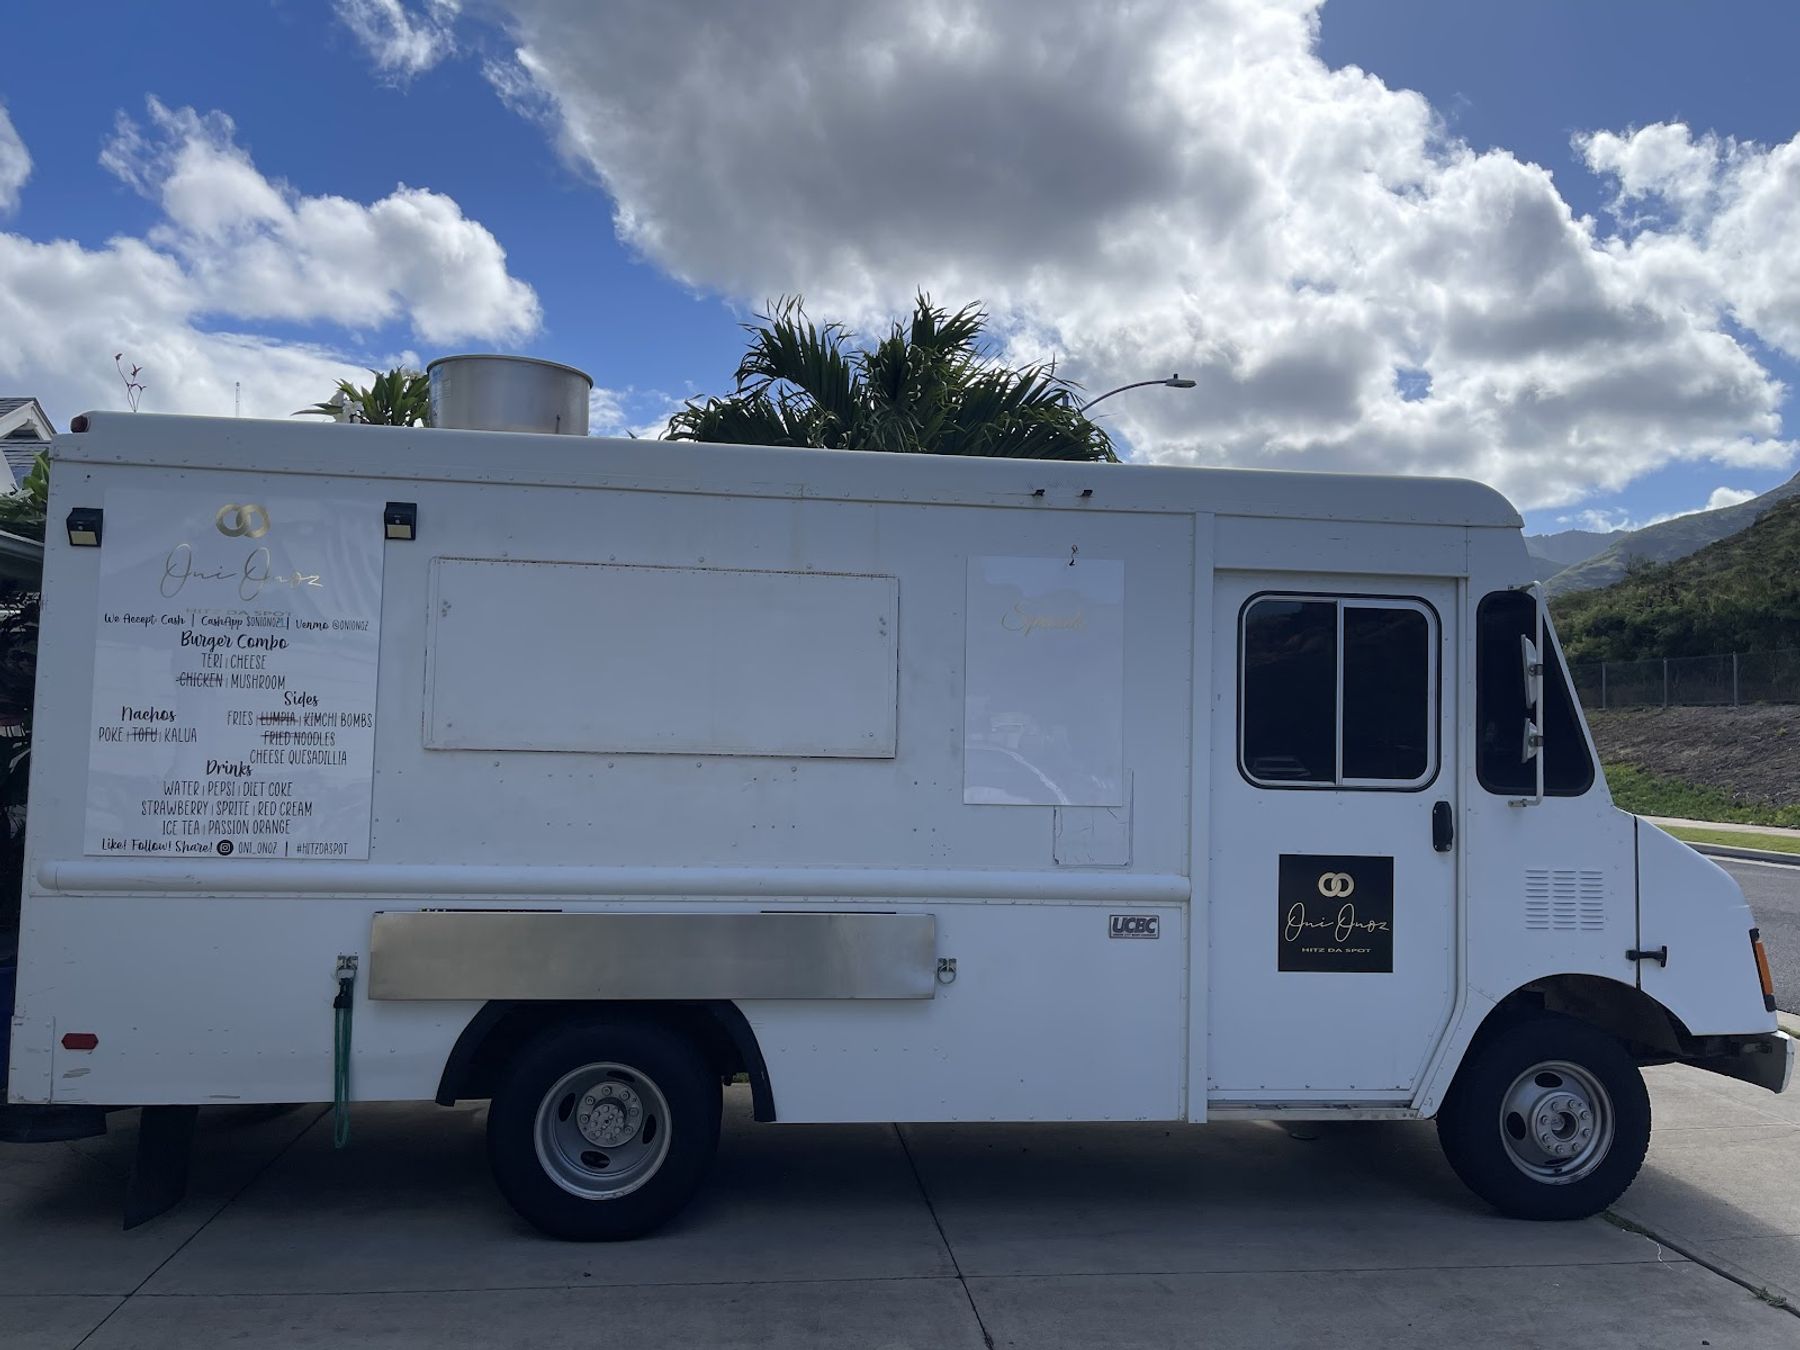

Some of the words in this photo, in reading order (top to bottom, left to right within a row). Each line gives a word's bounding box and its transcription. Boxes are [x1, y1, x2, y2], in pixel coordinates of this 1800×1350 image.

[160, 543, 236, 598] Oni
[104, 613, 120, 624] We
[123, 613, 157, 628] Accept
[161, 614, 185, 625] Cash
[201, 615, 244, 630] CashApp
[295, 619, 330, 631] Venmo
[181, 630, 233, 652] Burger
[237, 634, 289, 651] Combo
[202, 653, 223, 668] TERI
[230, 655, 267, 670] CHEESE
[179, 671, 223, 687] CHICKEN
[231, 673, 286, 690] MUSHROOM
[284, 691, 319, 708] Sides
[121, 705, 177, 722] Nachos
[227, 710, 254, 726] FRIES
[260, 711, 296, 726] LUMPIA
[303, 711, 338, 727] KIMCHI
[340, 712, 373, 728] BOMBS
[98, 726, 125, 742] POKE
[132, 727, 158, 742] TOFU
[164, 727, 198, 743] KALUA
[263, 730, 291, 746] FRIED
[293, 731, 336, 746] NOODLES
[249, 748, 286, 764] CHEESE
[206, 759, 253, 777] Drinks
[163, 780, 201, 796] WATER
[207, 781, 236, 797] PEPSI
[242, 781, 266, 797] DIET
[268, 781, 293, 797] COKE
[141, 799, 209, 816] STRAWBERRY
[216, 799, 250, 816] SPRITE
[258, 801, 278, 816] RED
[279, 802, 313, 817] CREAM
[162, 819, 179, 836] ICE
[181, 819, 200, 836] TEA
[208, 819, 250, 836] PASSION
[252, 819, 292, 835] ORANGE
[102, 837, 127, 852] Like!
[131, 839, 172, 852] Follow!
[175, 840, 213, 853] Share!
[296, 842, 349, 855] #HITZDASPOT
[1112, 917, 1158, 934] UCBC
[1284, 902, 1334, 942] Oni
[1334, 903, 1390, 943] Onoz
